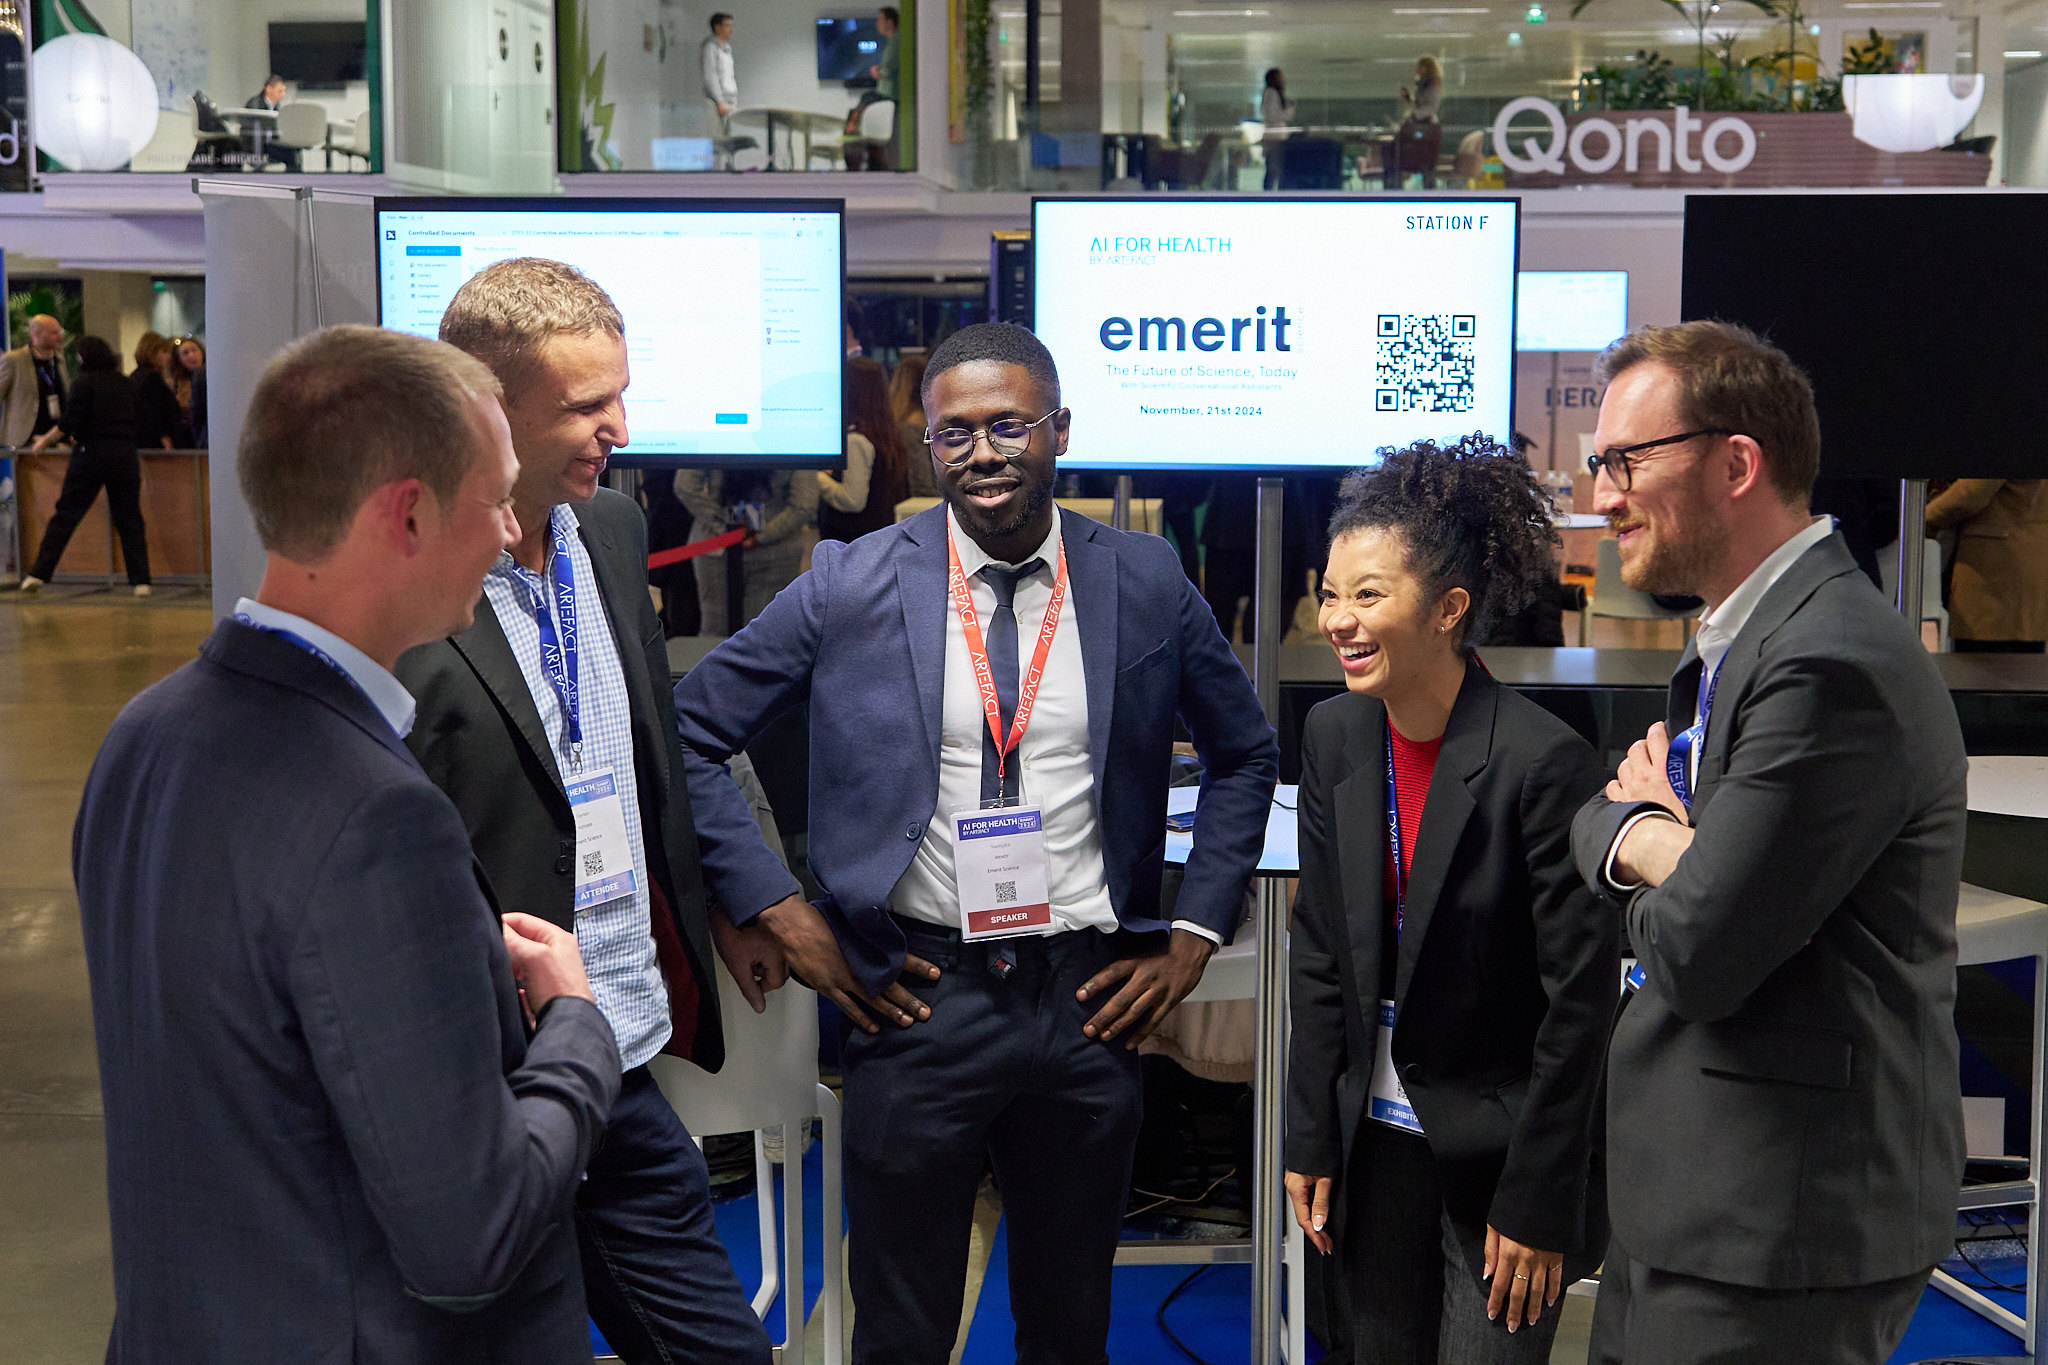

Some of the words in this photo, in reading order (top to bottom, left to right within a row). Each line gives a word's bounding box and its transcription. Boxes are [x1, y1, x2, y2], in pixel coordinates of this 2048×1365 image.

[1492, 96, 1757, 175] Qonto
[1405, 215, 1472, 230] STATION
[1479, 215, 1489, 230] F
[1090, 236, 1108, 252] AI
[1115, 236, 1151, 252] FOR
[1158, 236, 1232, 252] HEALTH
[1089, 256, 1103, 265] BY
[1099, 305, 1291, 353] emerit
[1106, 365, 1130, 377] The
[1133, 365, 1177, 377] Future
[1180, 365, 1194, 377] of
[1196, 365, 1256, 379] Science,
[1258, 365, 1298, 380] Today
[1120, 381, 1139, 390] With
[1140, 405, 1204, 417] November,
[1206, 405, 1231, 416] 21st
[1234, 405, 1262, 416] 2024
[949, 565, 977, 628] ARTEFACT
[558, 582, 577, 653] ARTEFACT
[1040, 581, 1067, 647] ARTEFACT
[971, 651, 999, 718] ARTEFACT
[1015, 667, 1043, 733] ARTEFACT
[569, 783, 595, 797] HEALTH
[962, 823, 971, 831] AI
[971, 821, 987, 830] FOR
[988, 818, 1018, 828] HEALTH
[1387, 809, 1400, 873] RTEFACT
[580, 881, 620, 901] ATTENDEE
[990, 912, 1028, 924] SPEAKER
[1387, 1106, 1419, 1123] EXHIBITO
